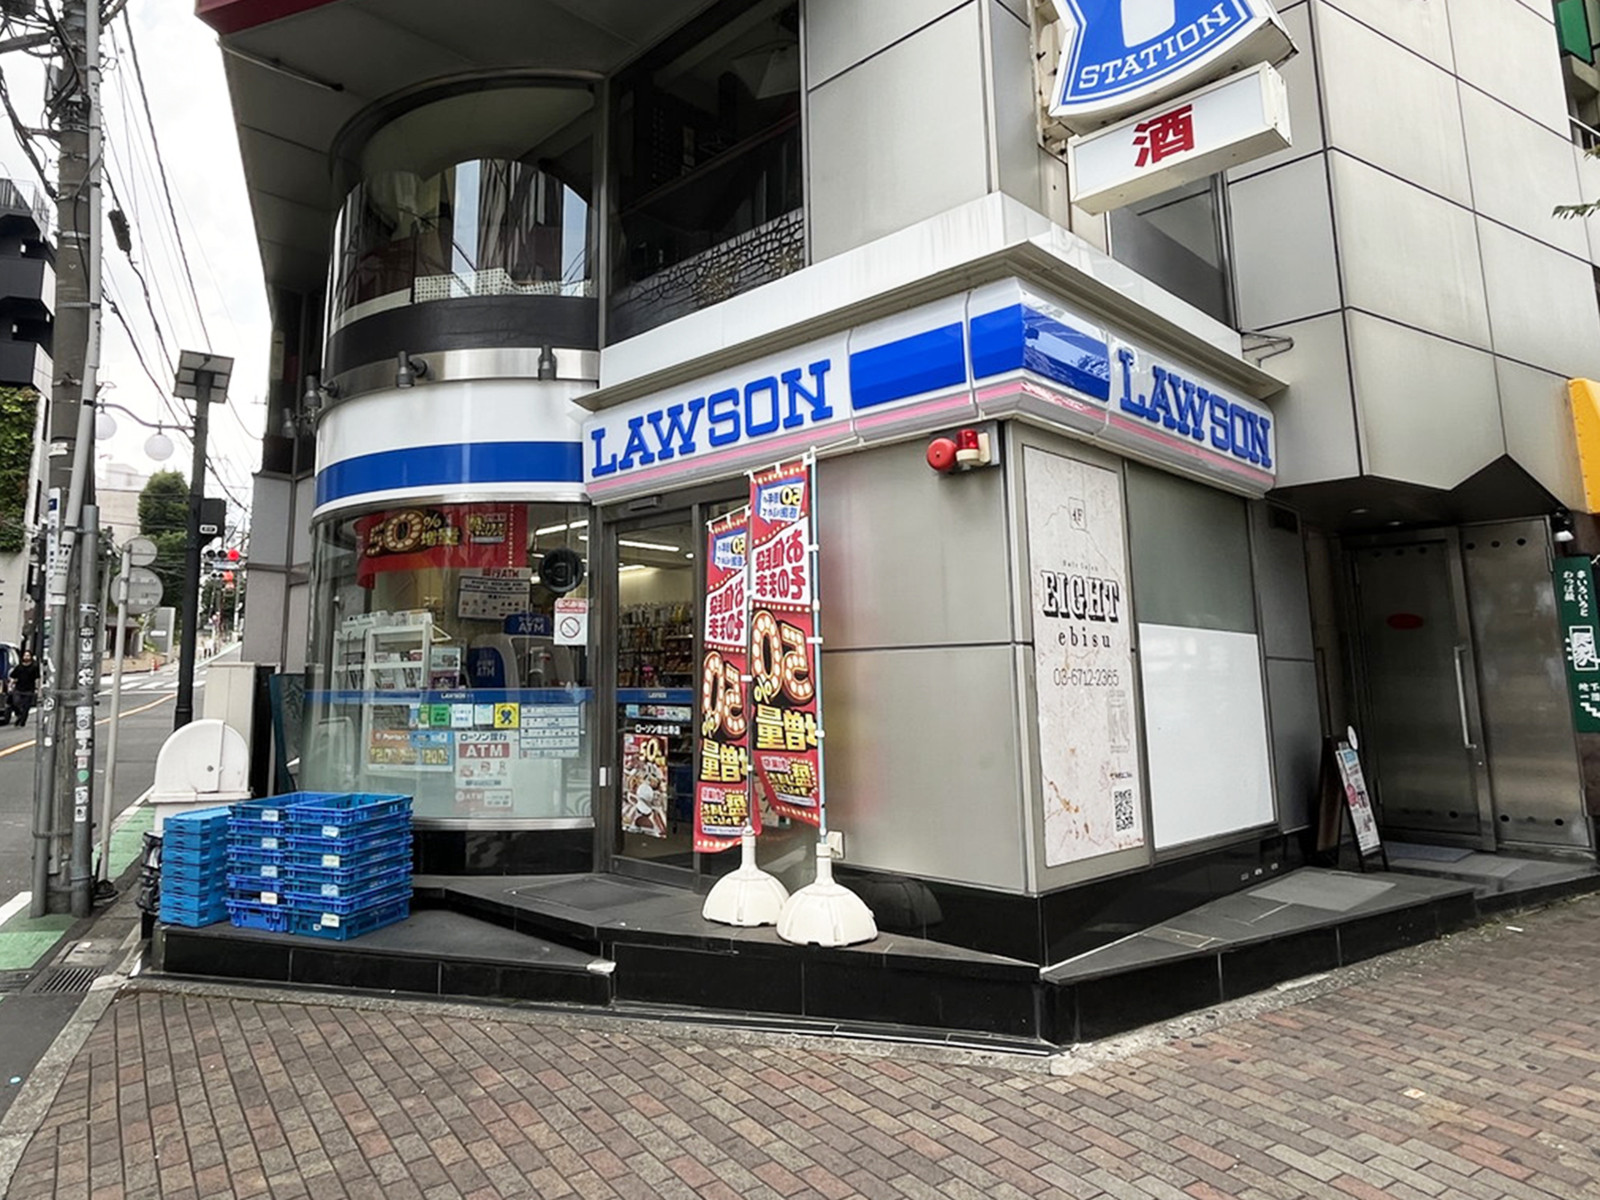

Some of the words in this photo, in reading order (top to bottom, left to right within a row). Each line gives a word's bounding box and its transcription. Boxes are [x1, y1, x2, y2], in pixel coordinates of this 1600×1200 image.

[1079, 2, 1232, 90] STATION
[1132, 104, 1195, 168] 酒
[591, 358, 834, 478] LAWSON
[1118, 348, 1272, 469] LAWSON
[366, 509, 441, 557] 50%
[1041, 571, 1120, 624] EIGHT
[518, 622, 545, 634] ATM
[1058, 626, 1111, 648] ebisu
[1053, 668, 1120, 687] 03-6712-2365
[460, 732, 508, 742] ローソン銀行
[466, 744, 503, 757] ATM
